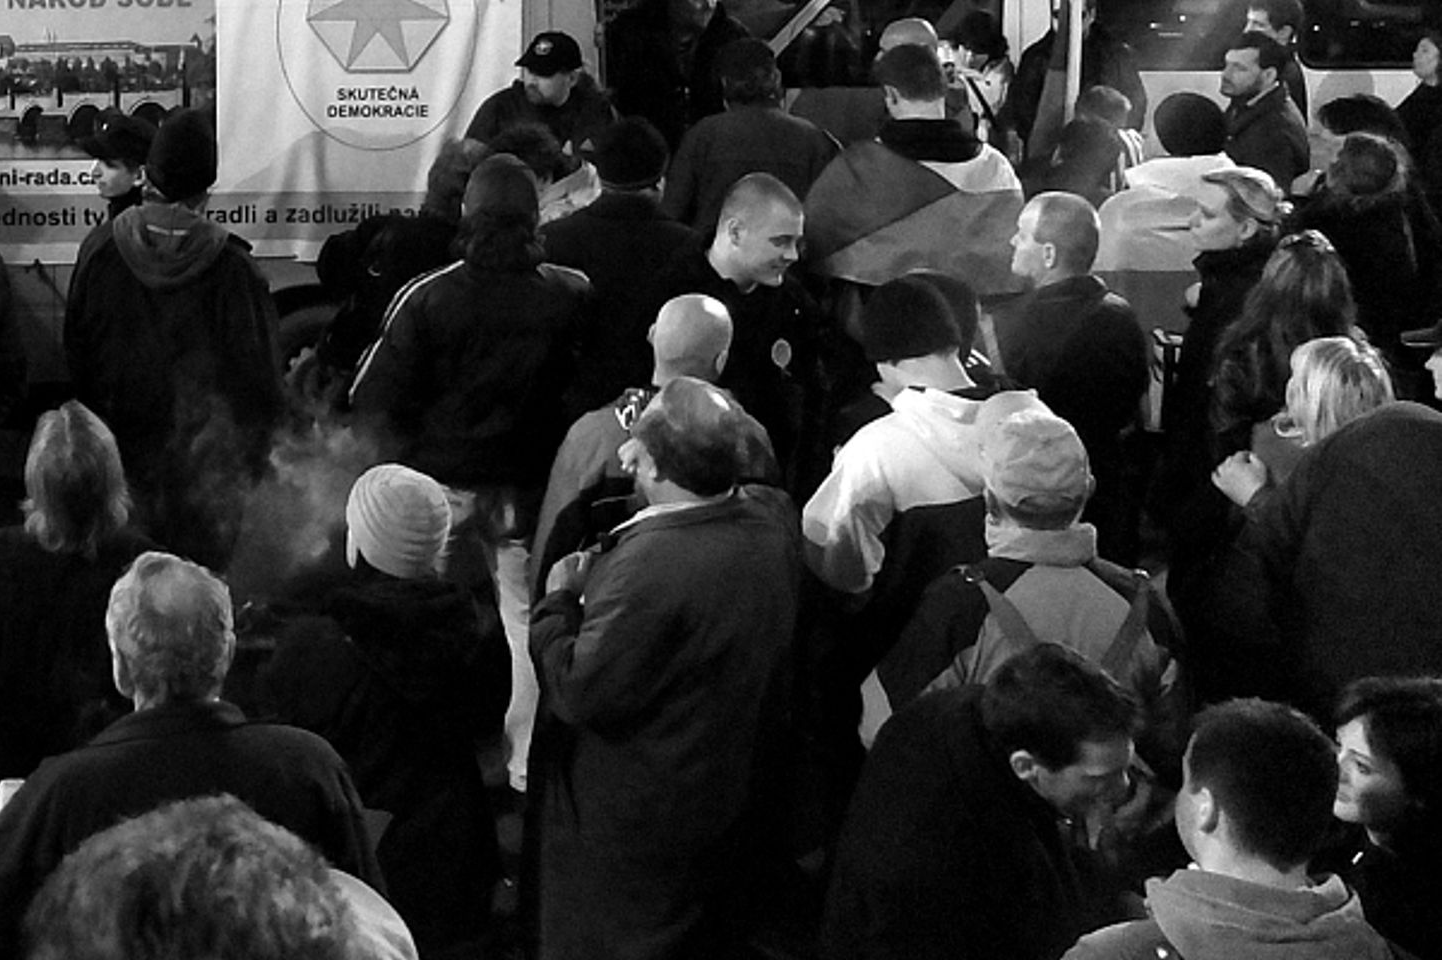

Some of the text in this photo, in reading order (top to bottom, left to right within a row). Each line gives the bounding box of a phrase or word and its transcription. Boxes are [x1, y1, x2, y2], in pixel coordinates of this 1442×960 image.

[337, 85, 420, 102] SKUTEČNÁ
[326, 104, 429, 118] DEMOKRACIE
[264, 209, 278, 224] a
